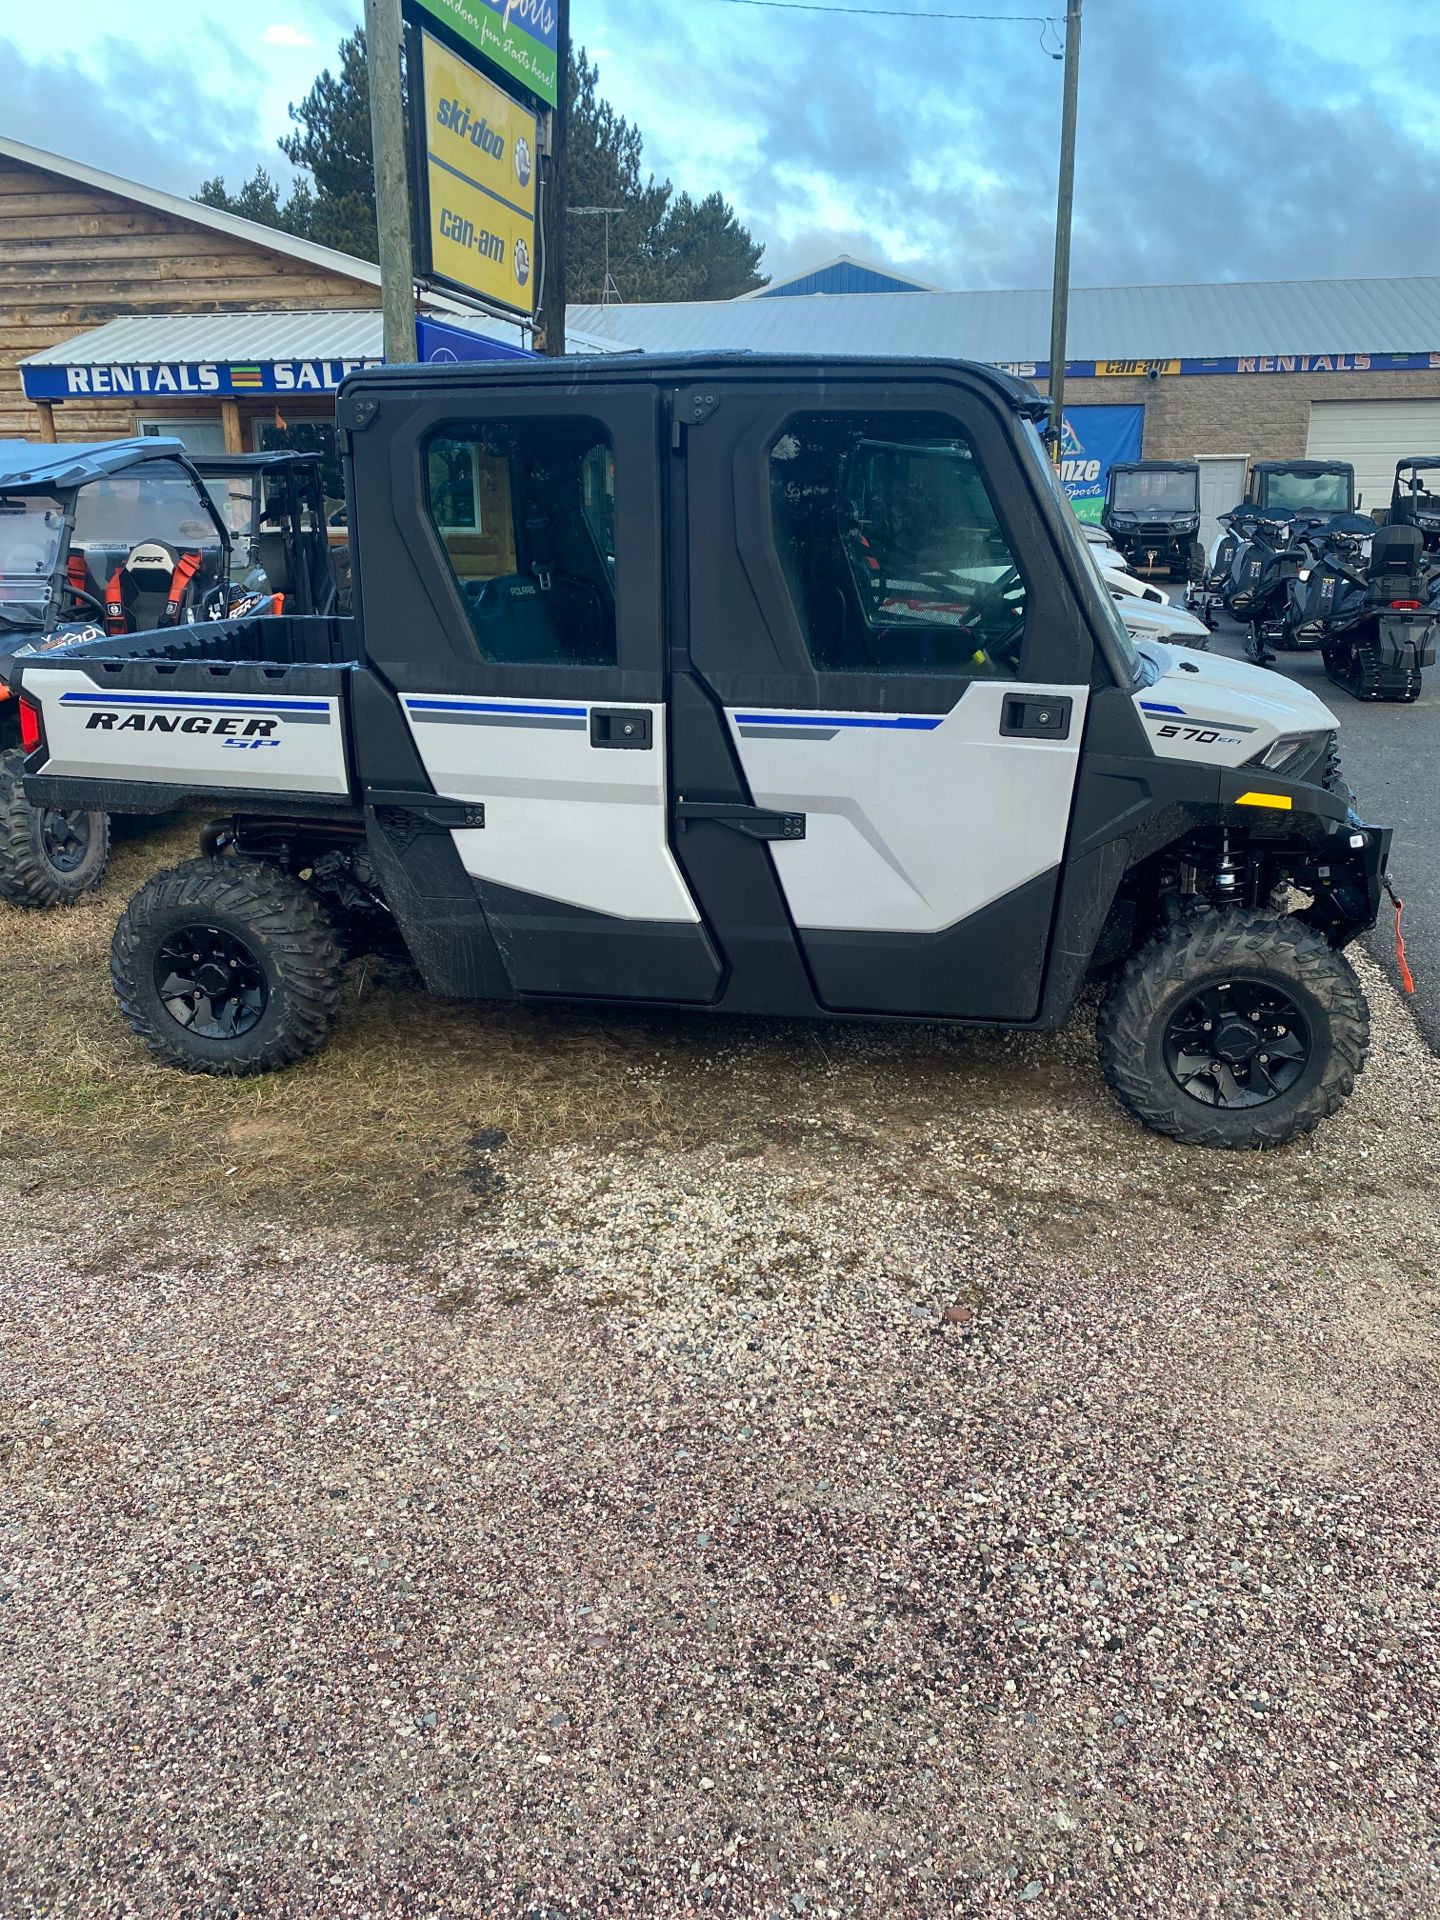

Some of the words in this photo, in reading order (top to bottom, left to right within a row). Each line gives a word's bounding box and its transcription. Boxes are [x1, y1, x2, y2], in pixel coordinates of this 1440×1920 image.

[491, 0, 555, 35] ports
[481, 15, 501, 46] fun
[503, 38, 530, 70] starts
[531, 57, 555, 88] here!
[437, 97, 505, 161] ski-doo
[440, 207, 505, 264] can-am
[994, 362, 1036, 377] RIS
[1105, 359, 1171, 374] can-am
[1237, 354, 1371, 373] RENTALS
[66, 364, 220, 392] RENTALS
[1061, 459, 1101, 481] nze
[1064, 483, 1102, 501] Sports
[510, 586, 535, 596] POLARIS
[85, 712, 278, 736] RANGER
[1156, 725, 1220, 744] 570
[1217, 737, 1242, 745] EFI
[221, 738, 281, 749] SP
